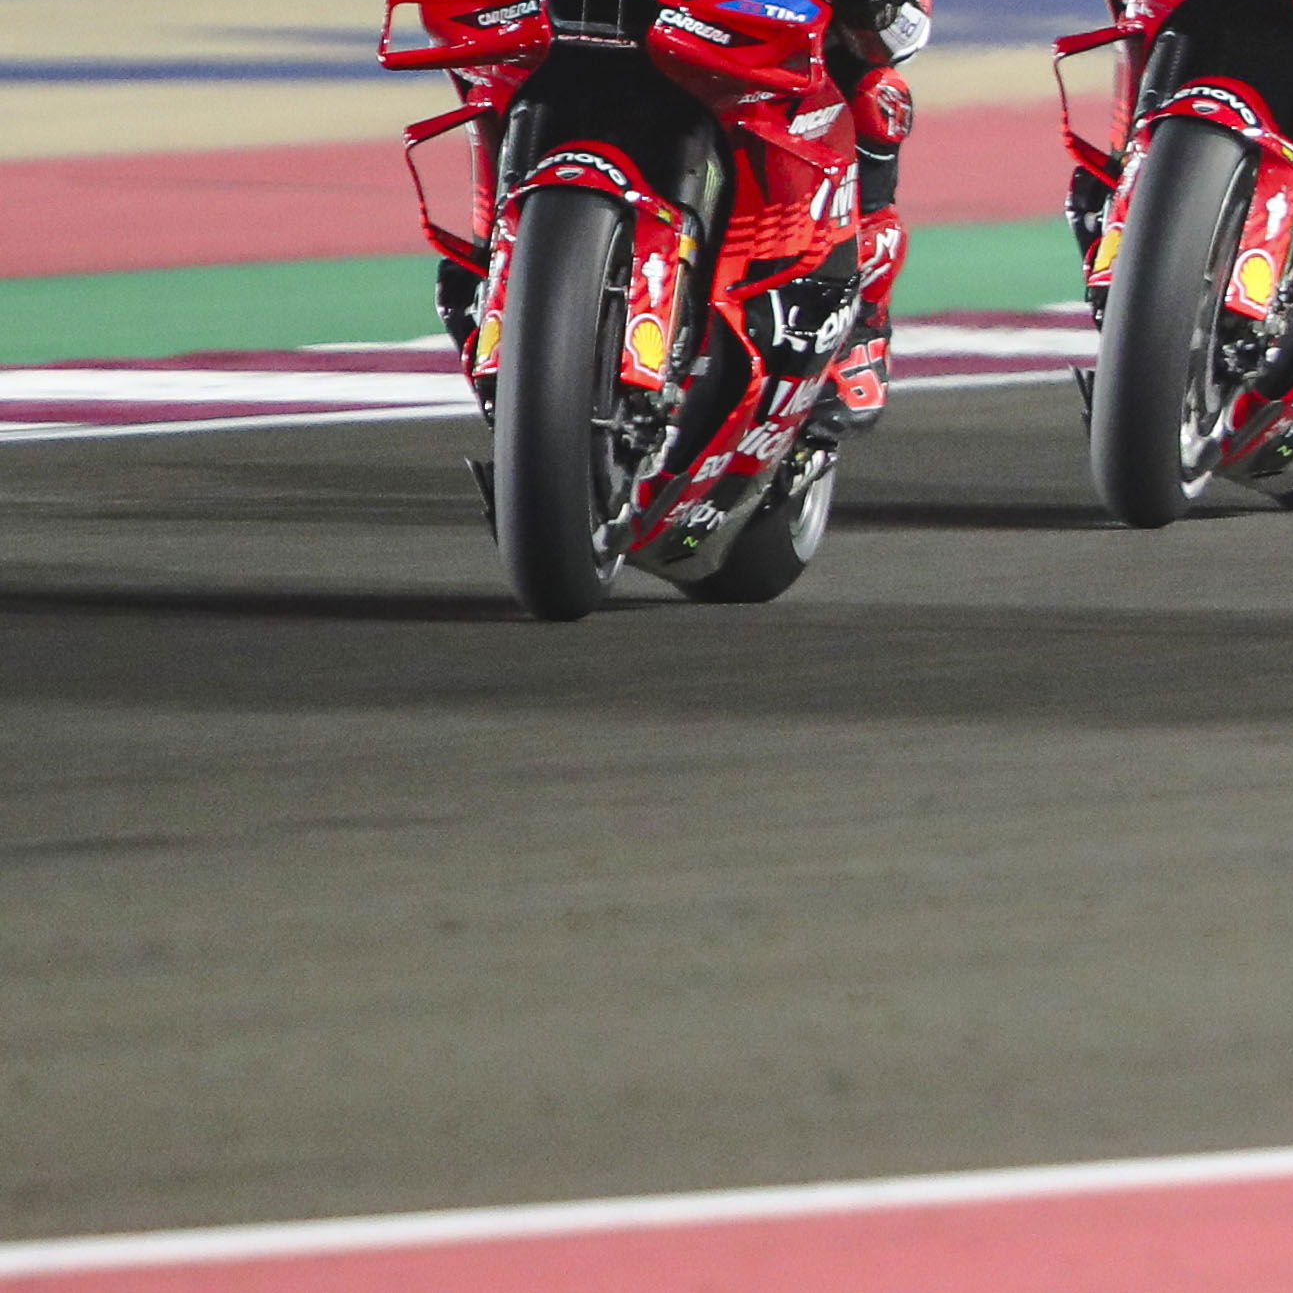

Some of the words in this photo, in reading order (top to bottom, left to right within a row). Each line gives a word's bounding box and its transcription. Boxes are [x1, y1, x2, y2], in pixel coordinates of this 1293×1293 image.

[477, 0, 540, 27] CARRERA
[659, 8, 732, 45] CARRERA
[764, 4, 807, 23] TIM
